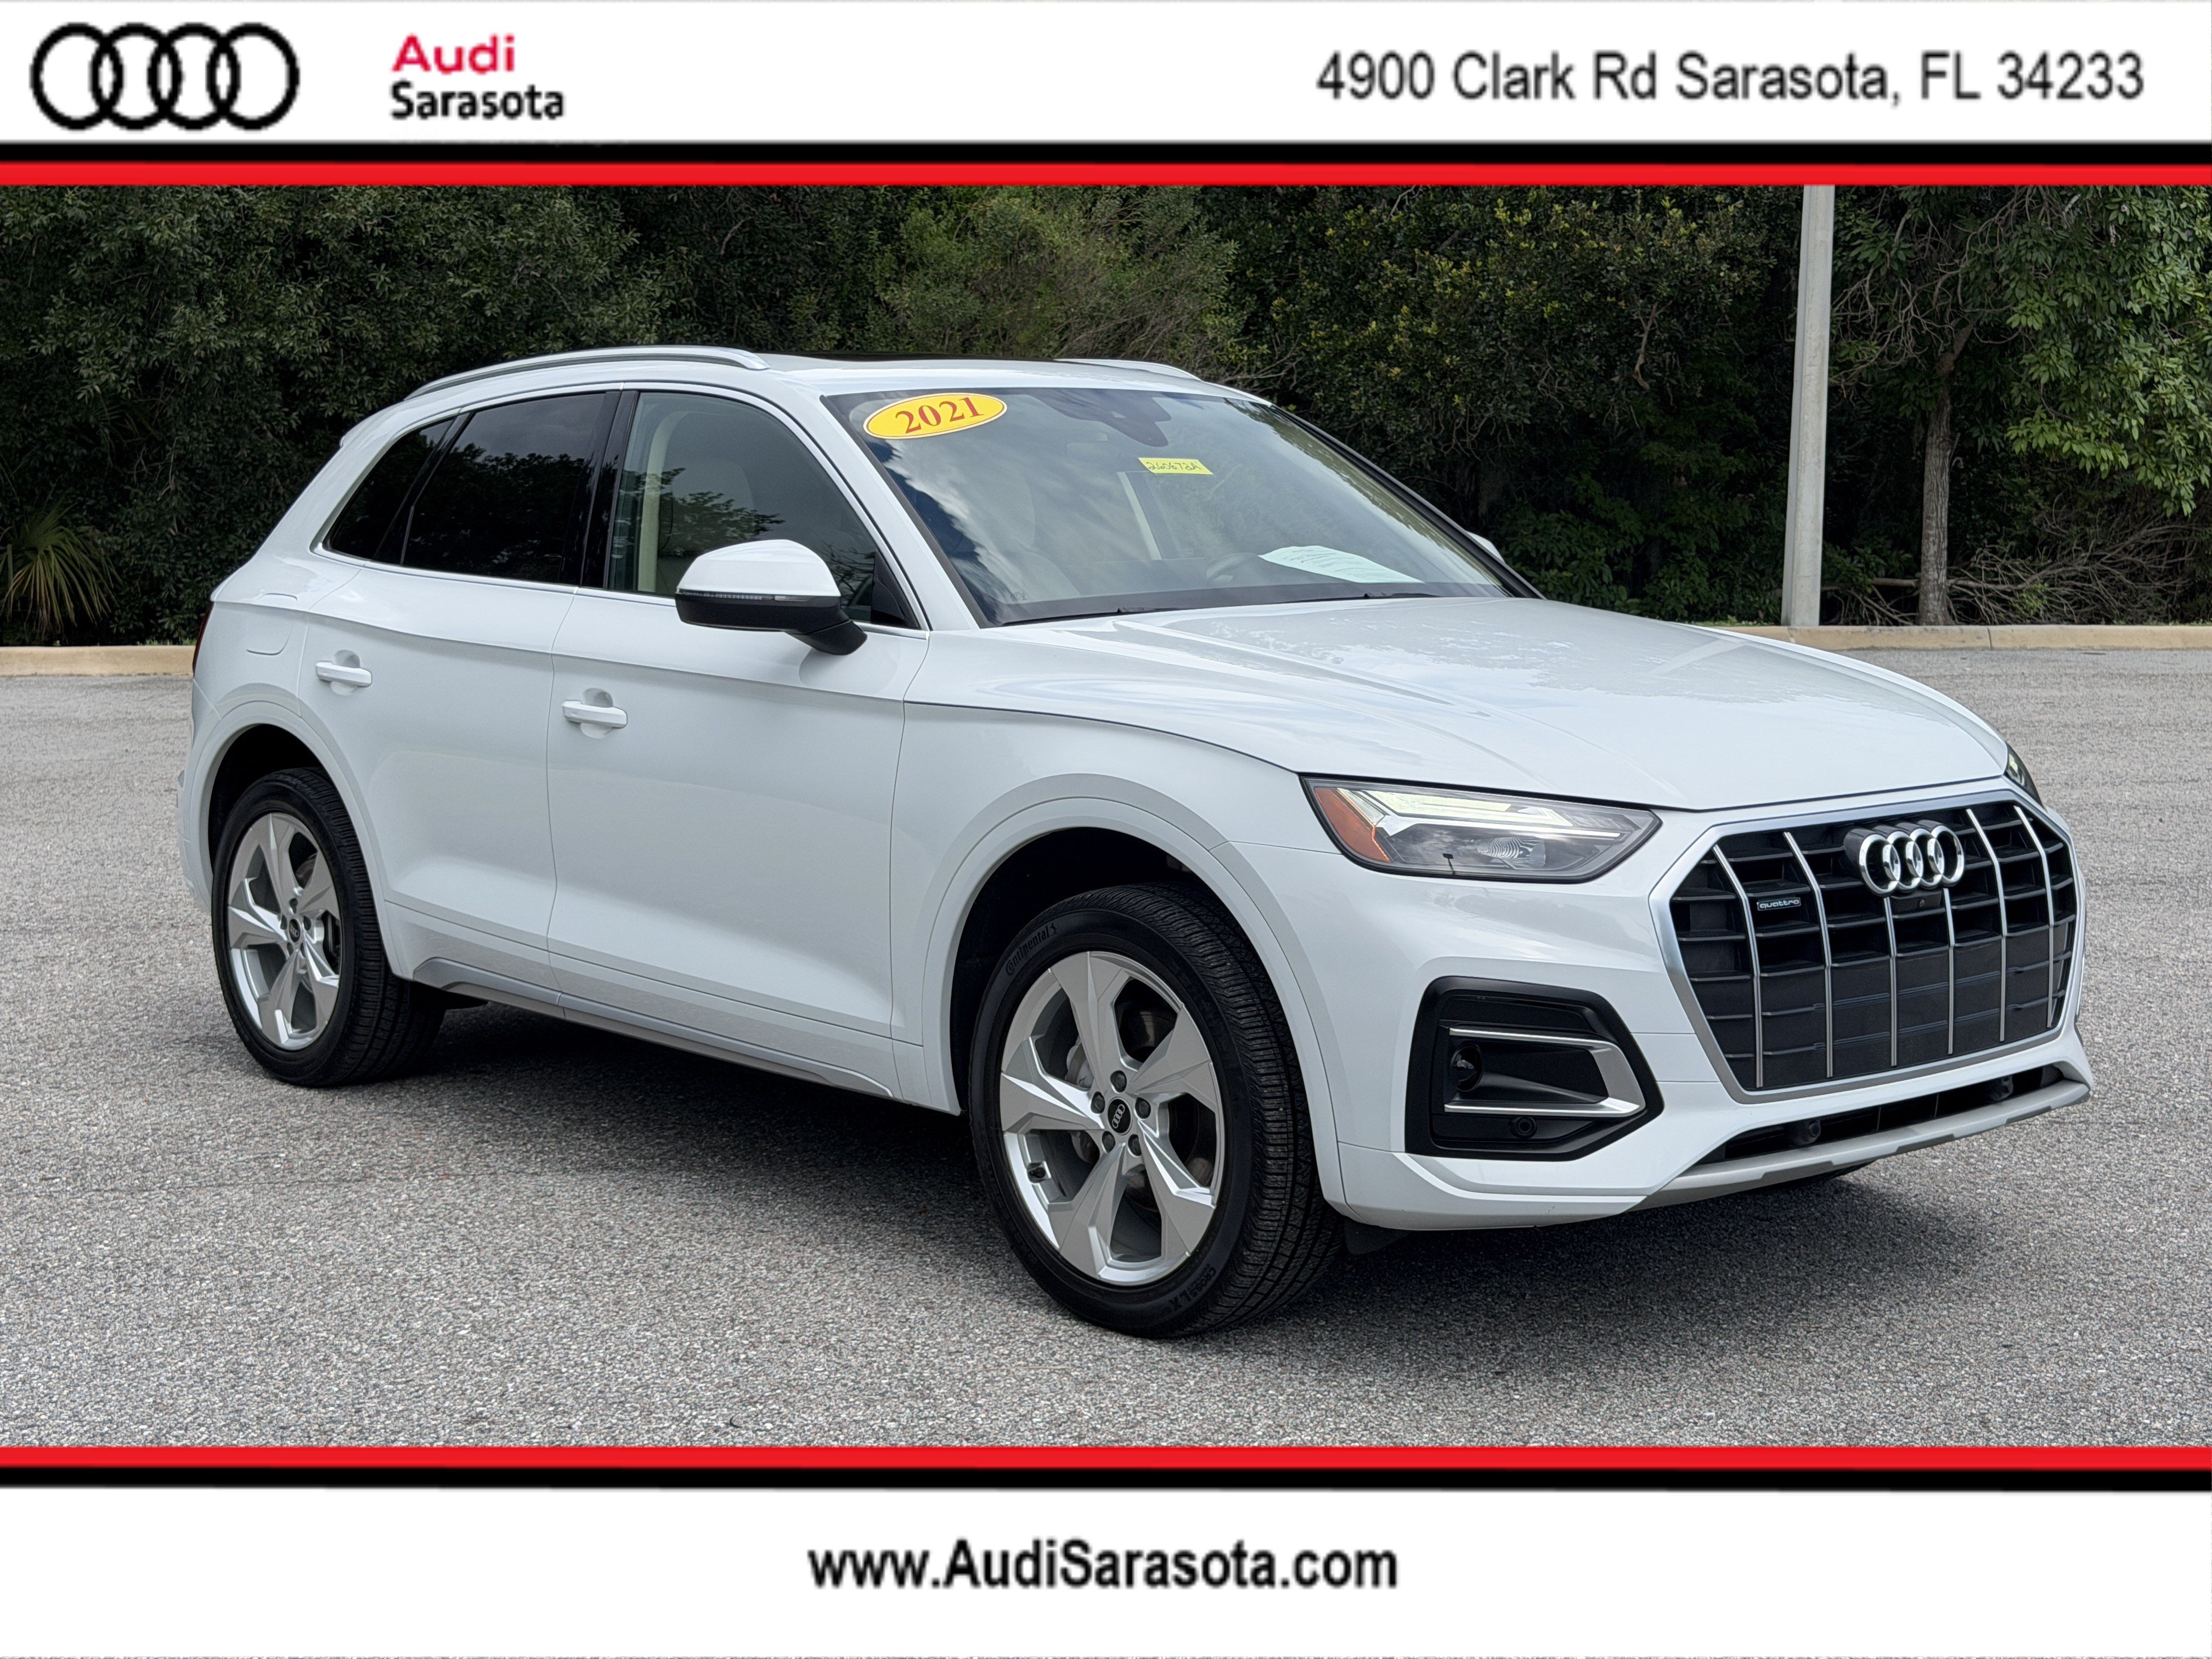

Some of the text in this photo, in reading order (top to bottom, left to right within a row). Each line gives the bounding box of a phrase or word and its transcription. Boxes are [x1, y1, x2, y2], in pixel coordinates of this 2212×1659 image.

[895, 397, 985, 434] 2021
[1759, 899, 1800, 909] quattro
[1006, 926, 1050, 976] Continental
